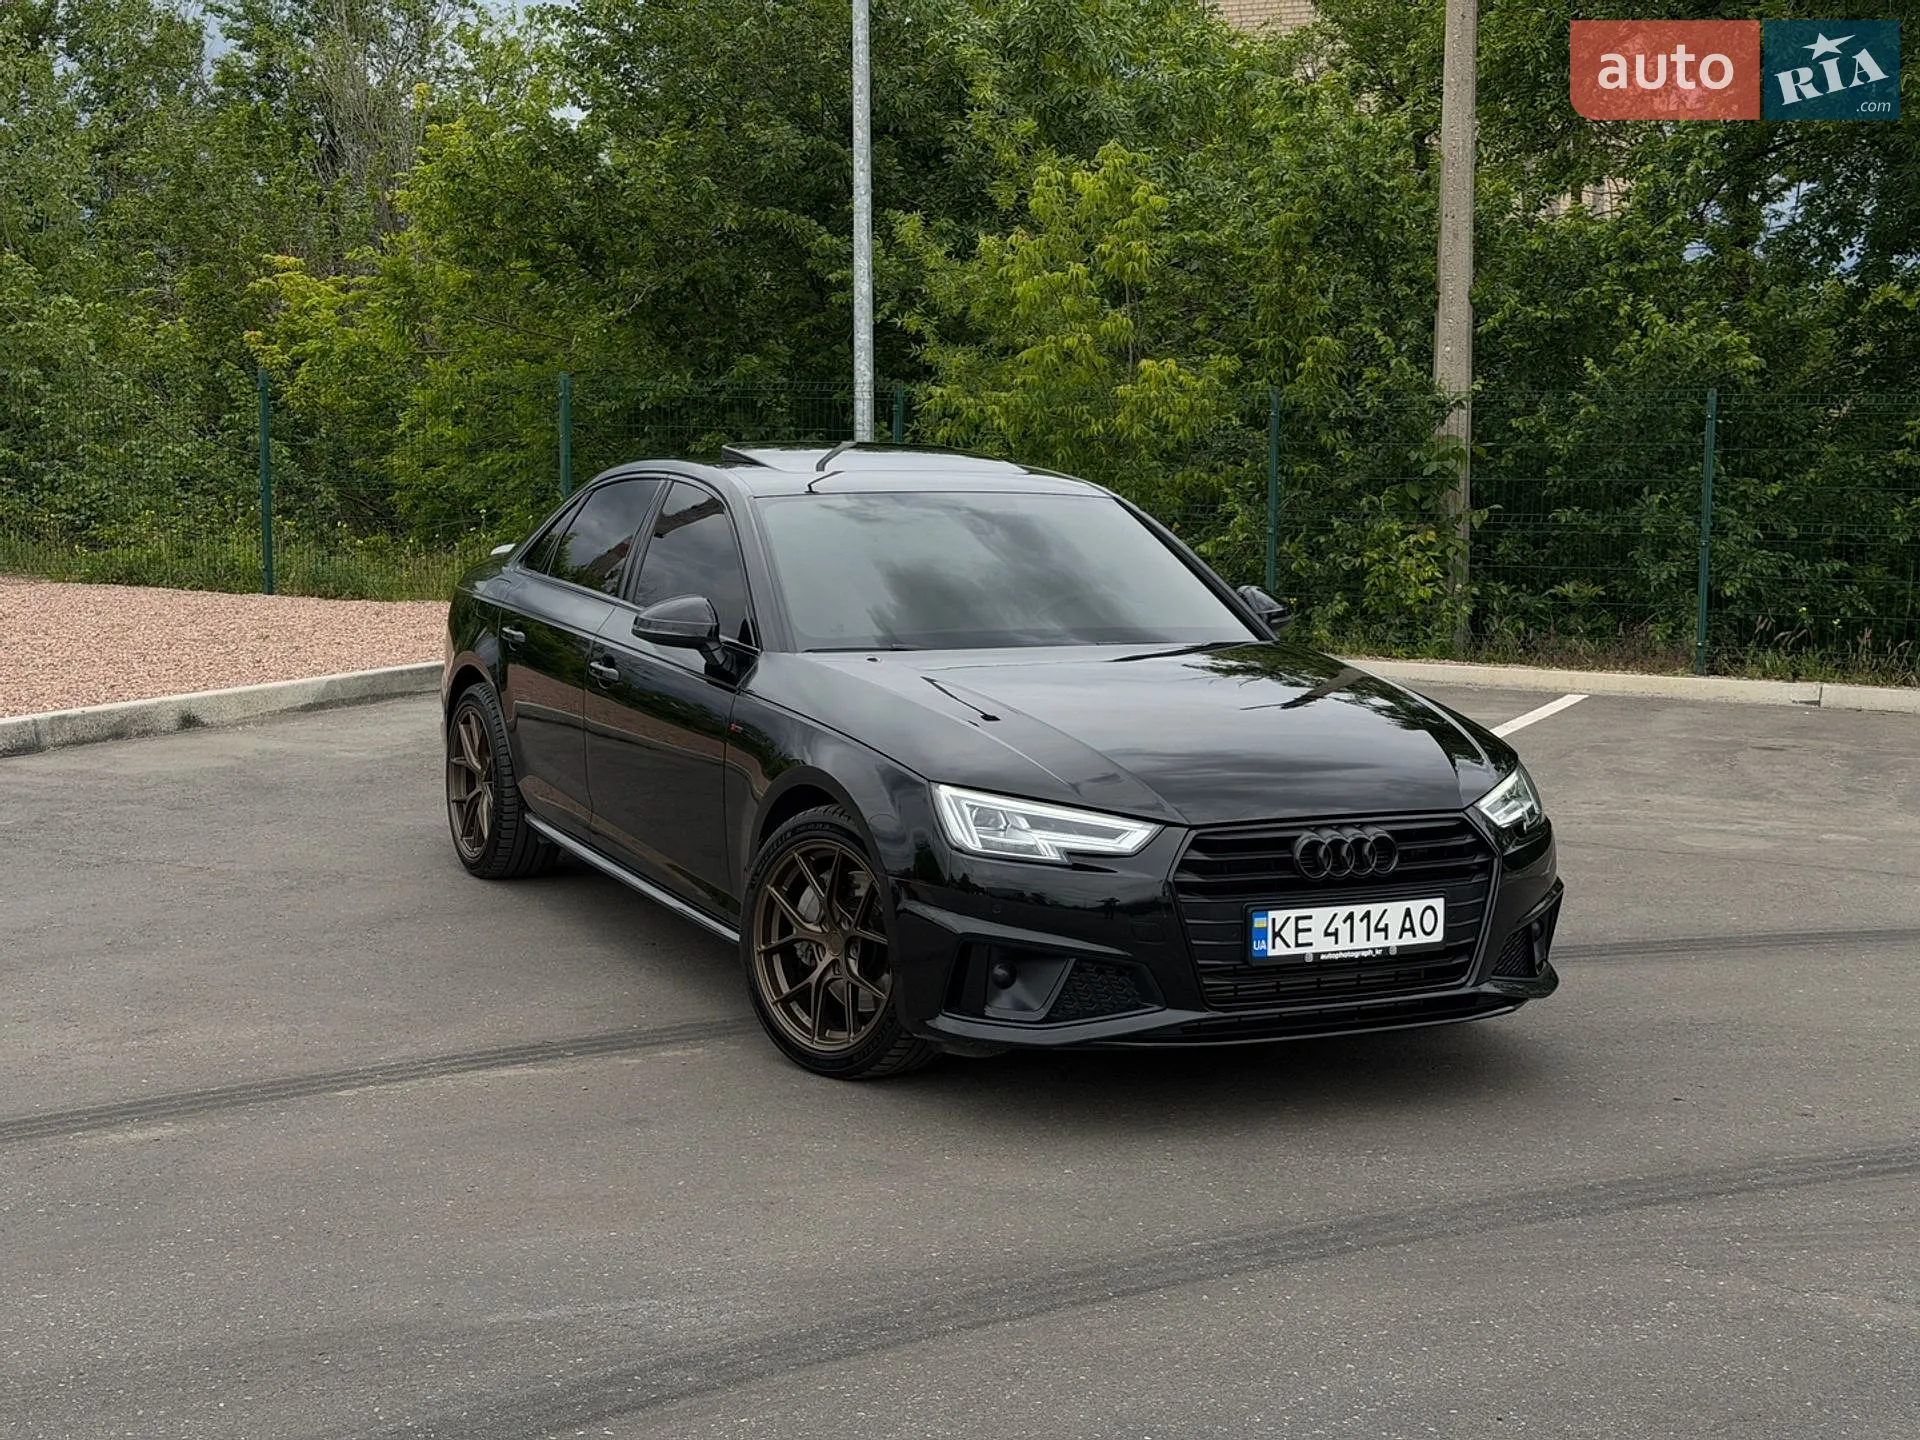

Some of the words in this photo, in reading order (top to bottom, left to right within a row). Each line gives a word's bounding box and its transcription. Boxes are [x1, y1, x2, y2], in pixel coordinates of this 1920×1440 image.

[1271, 915, 1313, 949] KE
[1323, 909, 1389, 945] 4114
[1398, 905, 1438, 939] AO
[1253, 941, 1266, 950] UA
